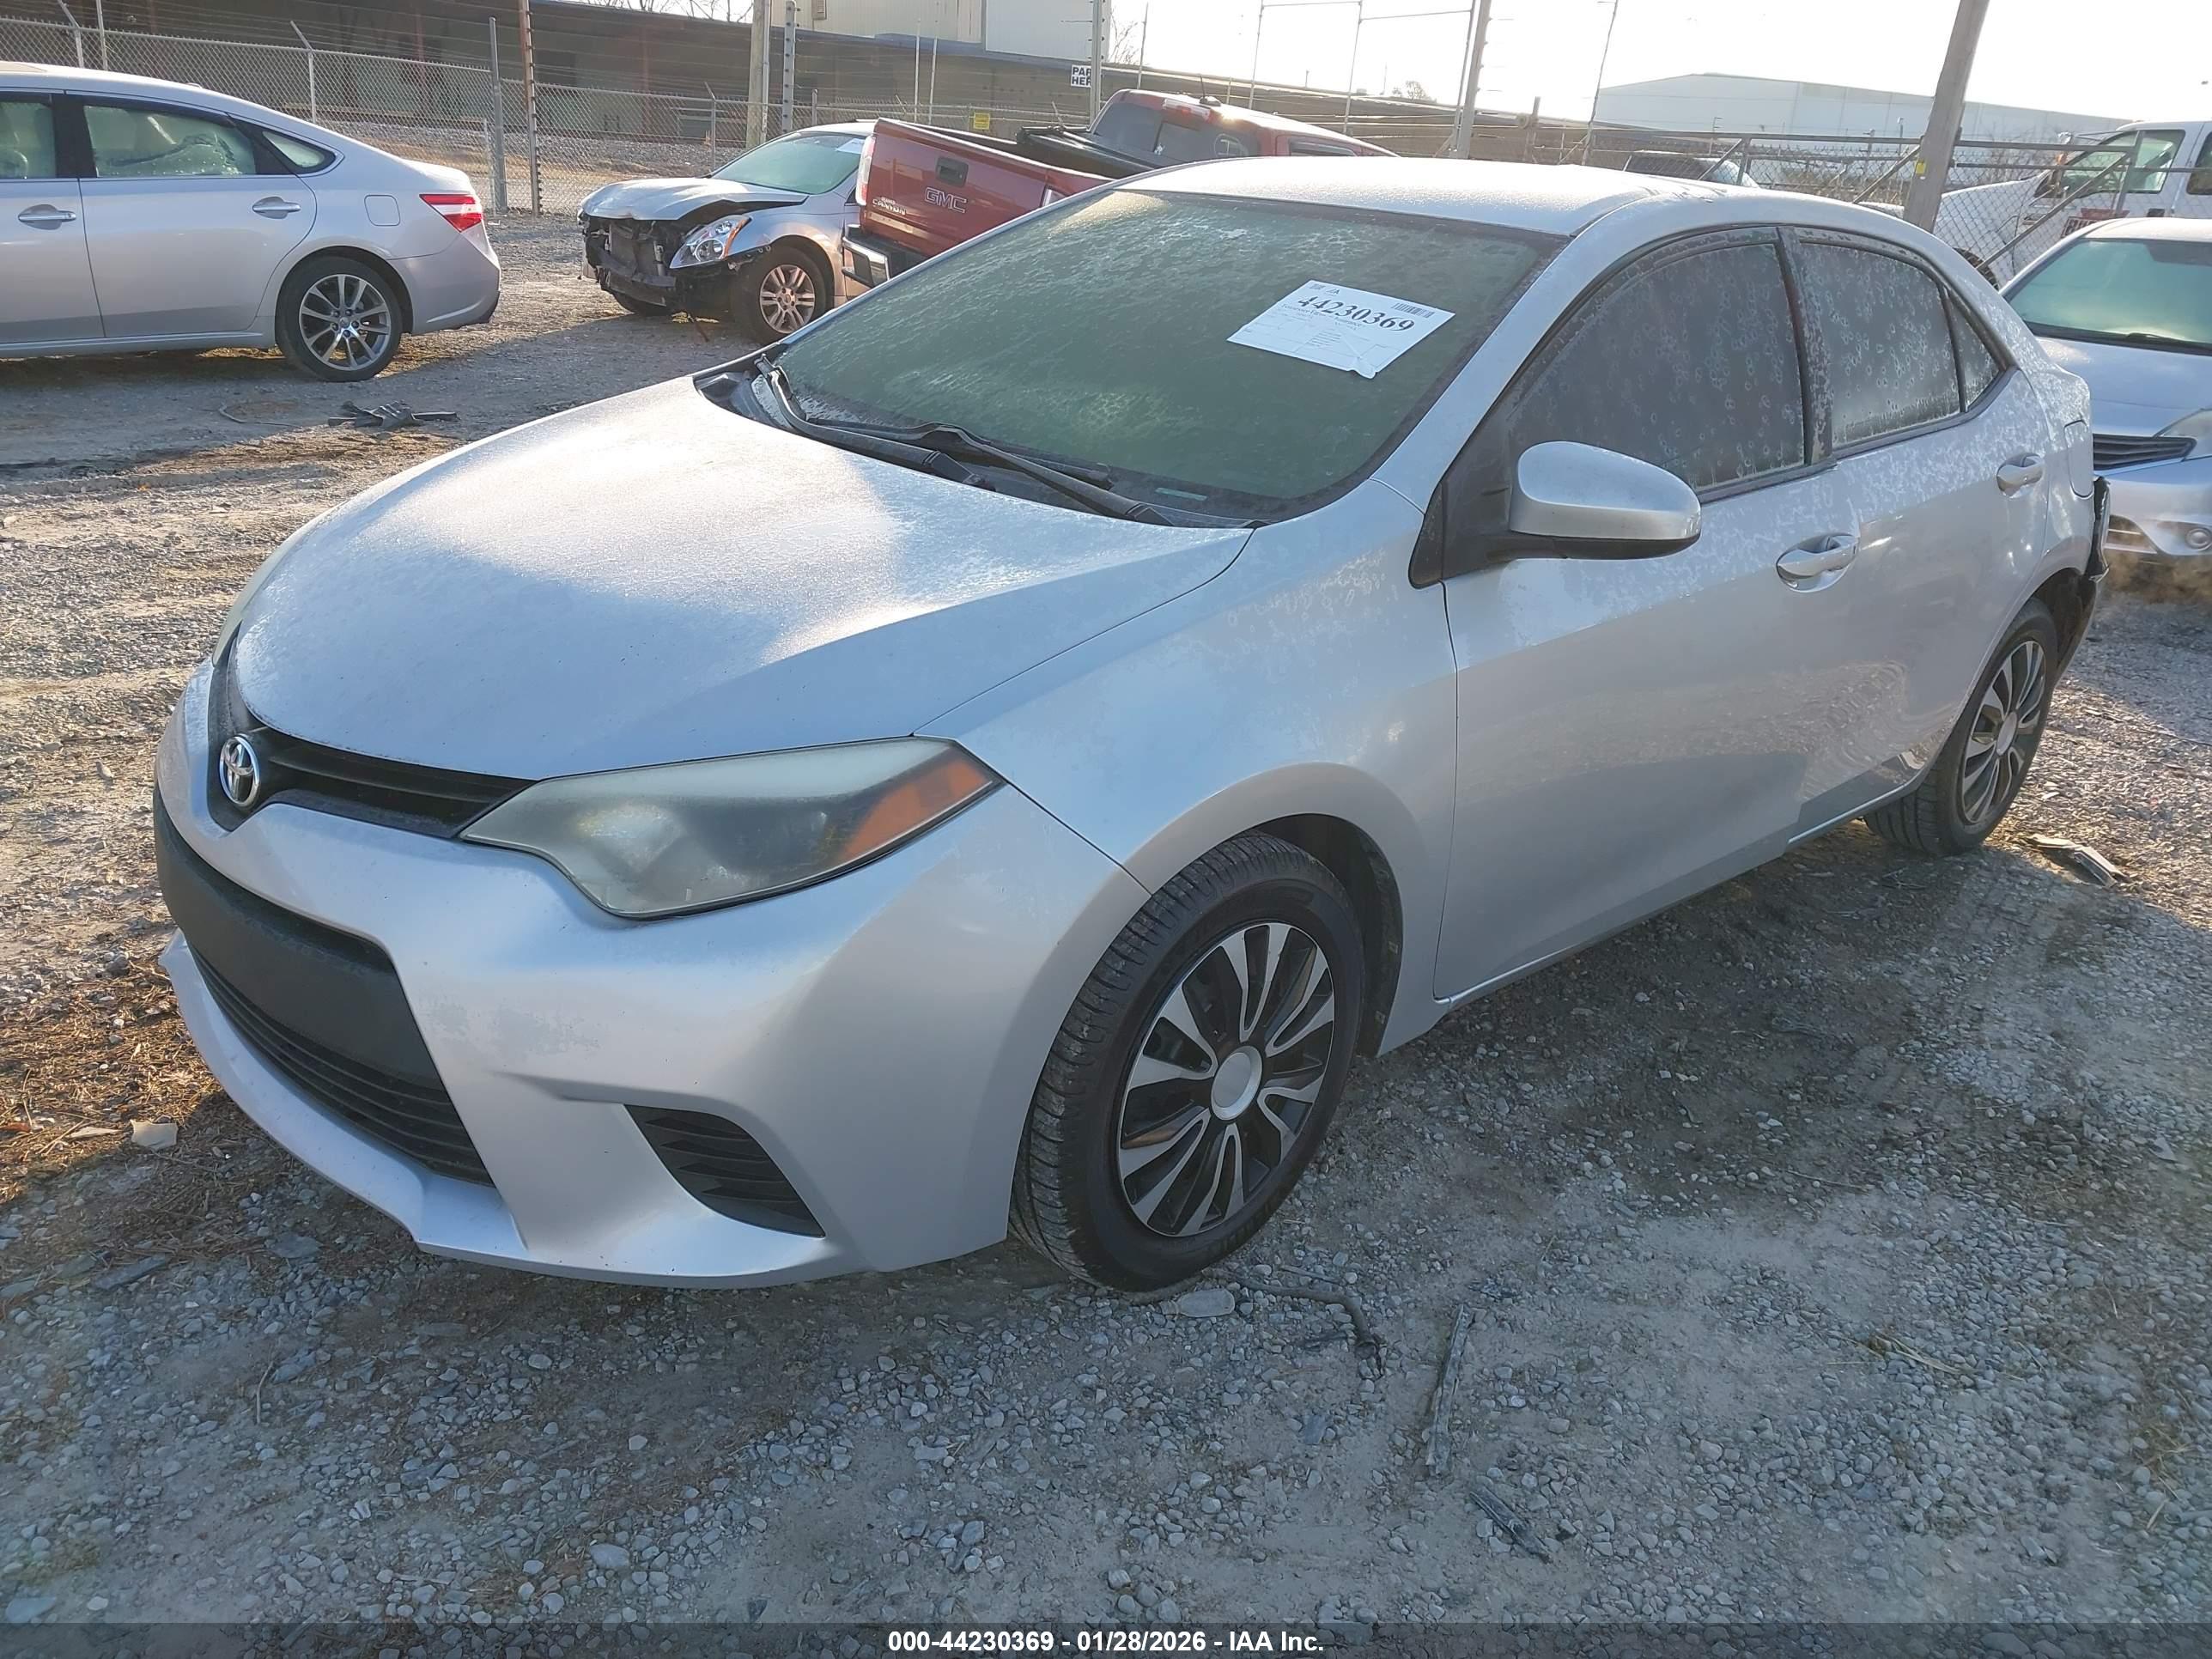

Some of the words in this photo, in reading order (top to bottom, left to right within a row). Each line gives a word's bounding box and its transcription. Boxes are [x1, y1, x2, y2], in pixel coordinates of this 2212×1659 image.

[1072, 67, 1091, 76] PAR
[1072, 76, 1091, 86] HER
[872, 198, 907, 216] CANYON
[924, 186, 967, 213] GMC
[1297, 295, 1415, 331] 44230369
